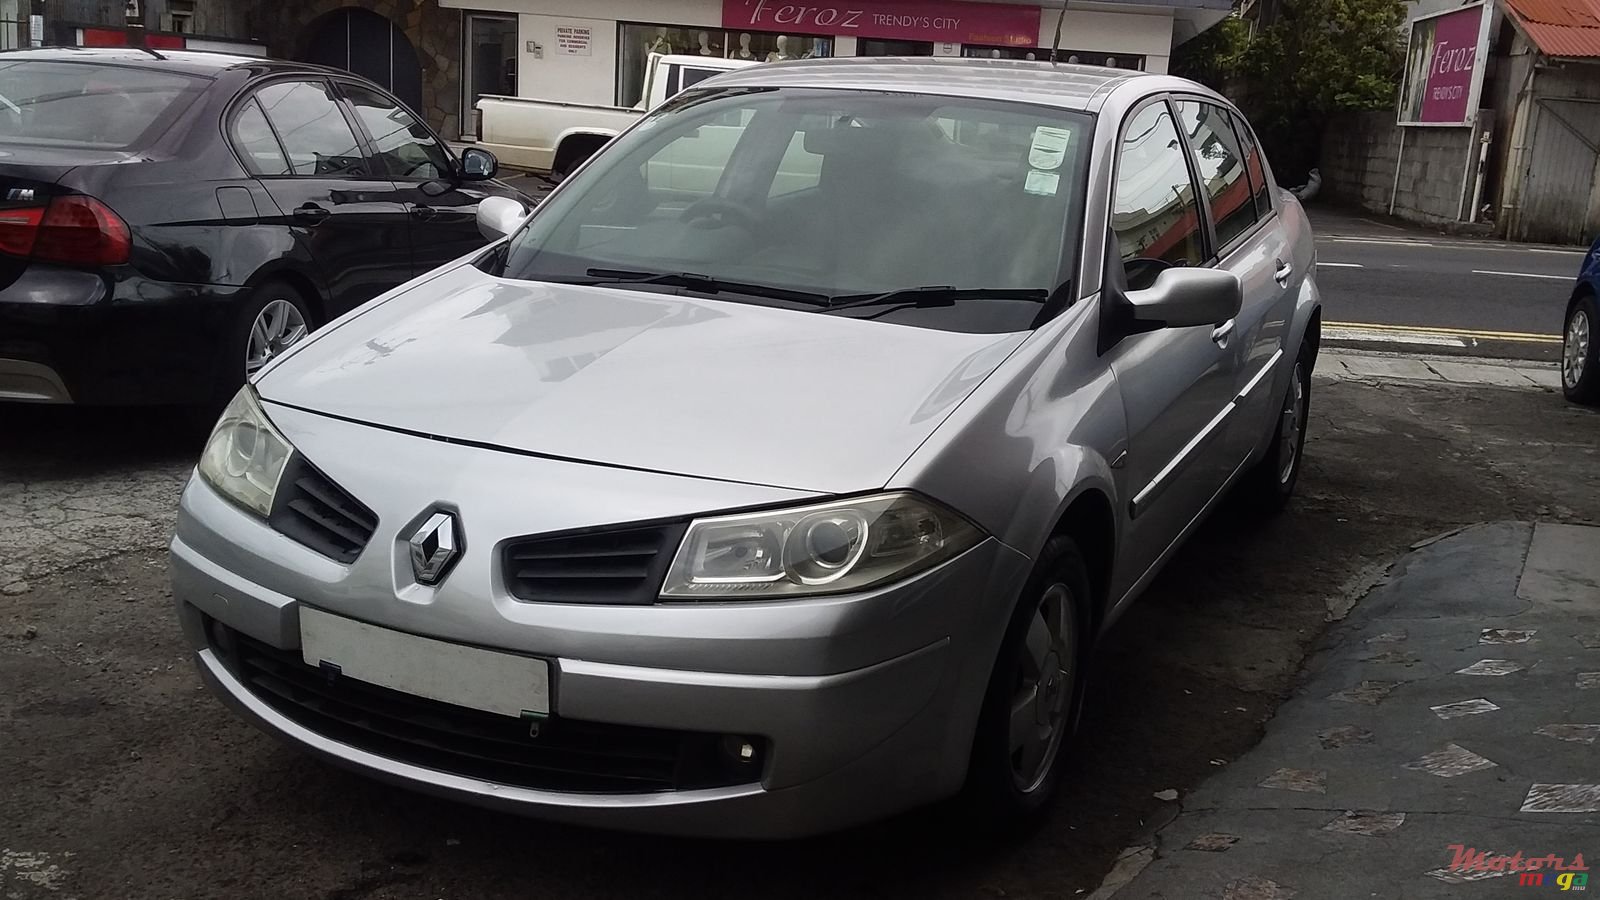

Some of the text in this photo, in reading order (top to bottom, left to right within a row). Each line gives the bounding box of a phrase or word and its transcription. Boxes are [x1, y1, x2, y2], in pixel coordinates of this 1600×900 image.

[873, 13, 929, 28] TRENDY'S
[933, 17, 960, 30] CITY
[1430, 40, 1476, 78] Feroz
